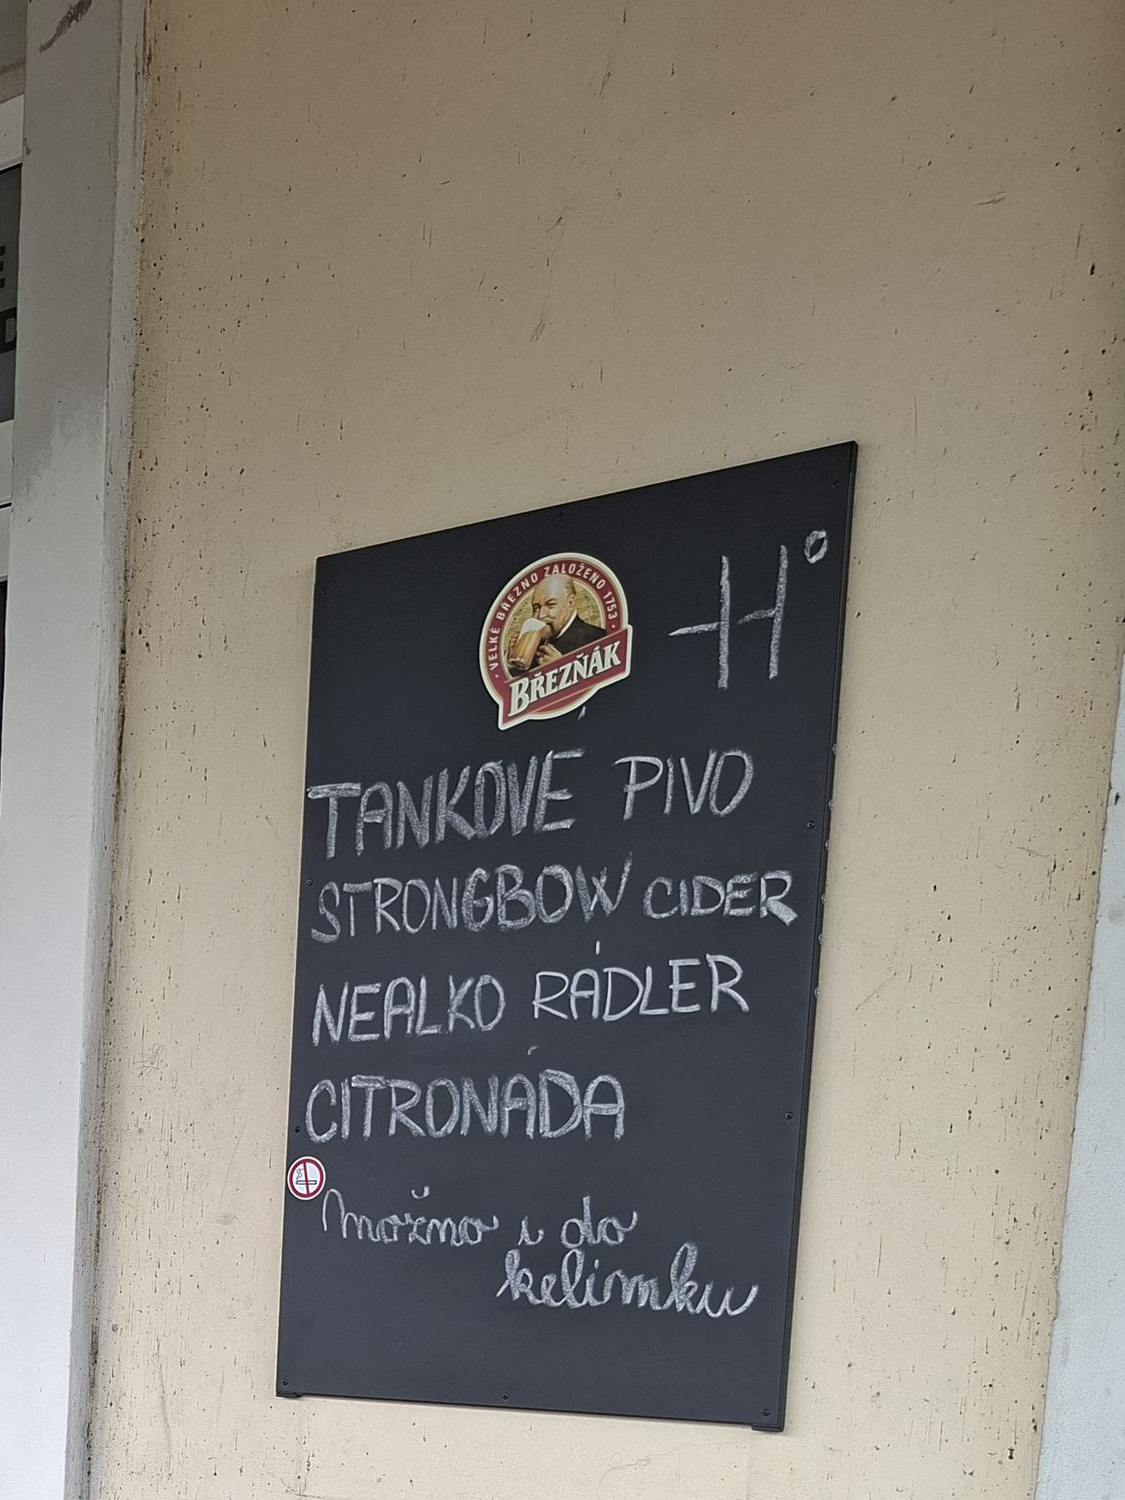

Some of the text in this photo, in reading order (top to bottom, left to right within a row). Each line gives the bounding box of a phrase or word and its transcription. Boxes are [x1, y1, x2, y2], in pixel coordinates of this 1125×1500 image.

[487, 627, 500, 671] VELKÉ
[544, 563, 606, 589] ZALOŽENO
[603, 591, 618, 620] 1753
[507, 641, 622, 718] BŘEZŇÁK
[613, 748, 754, 820] PIVO
[311, 851, 799, 943] STRONGBOW CIDER
[311, 941, 750, 1047] NEALKO RÁDLER
[305, 1045, 625, 1143] CITRONÁDA
[560, 1196, 638, 1249] do
